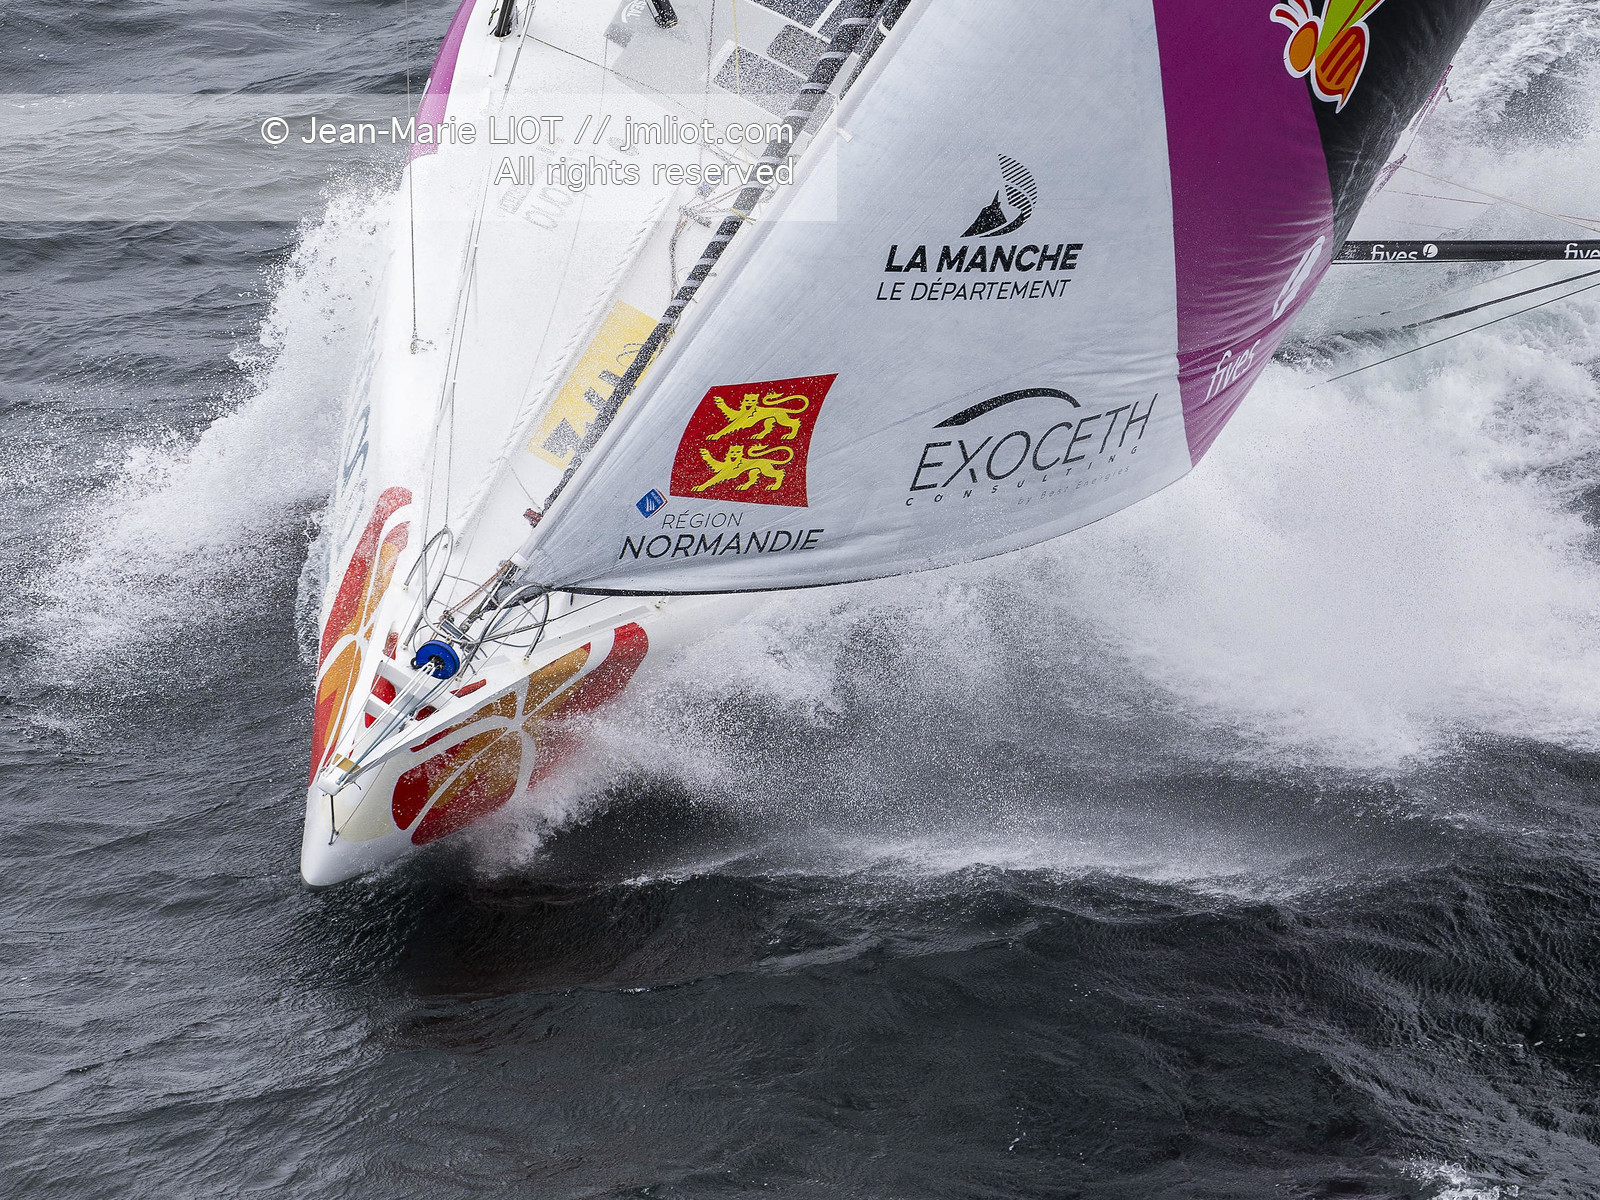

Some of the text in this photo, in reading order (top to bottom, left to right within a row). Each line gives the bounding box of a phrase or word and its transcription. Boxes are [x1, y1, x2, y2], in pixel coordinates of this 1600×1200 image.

[884, 243, 1084, 273] LA MANCHE
[1370, 243, 1419, 260] fives
[1564, 242, 1600, 259] five
[876, 277, 1072, 301] LE DÉPARTEMENT
[1202, 338, 1261, 404] fives
[909, 392, 1158, 492] EXOCETH
[905, 446, 1138, 506] CONSULTING
[661, 510, 744, 530] RÉGION
[618, 528, 825, 560] NORMANDIE
